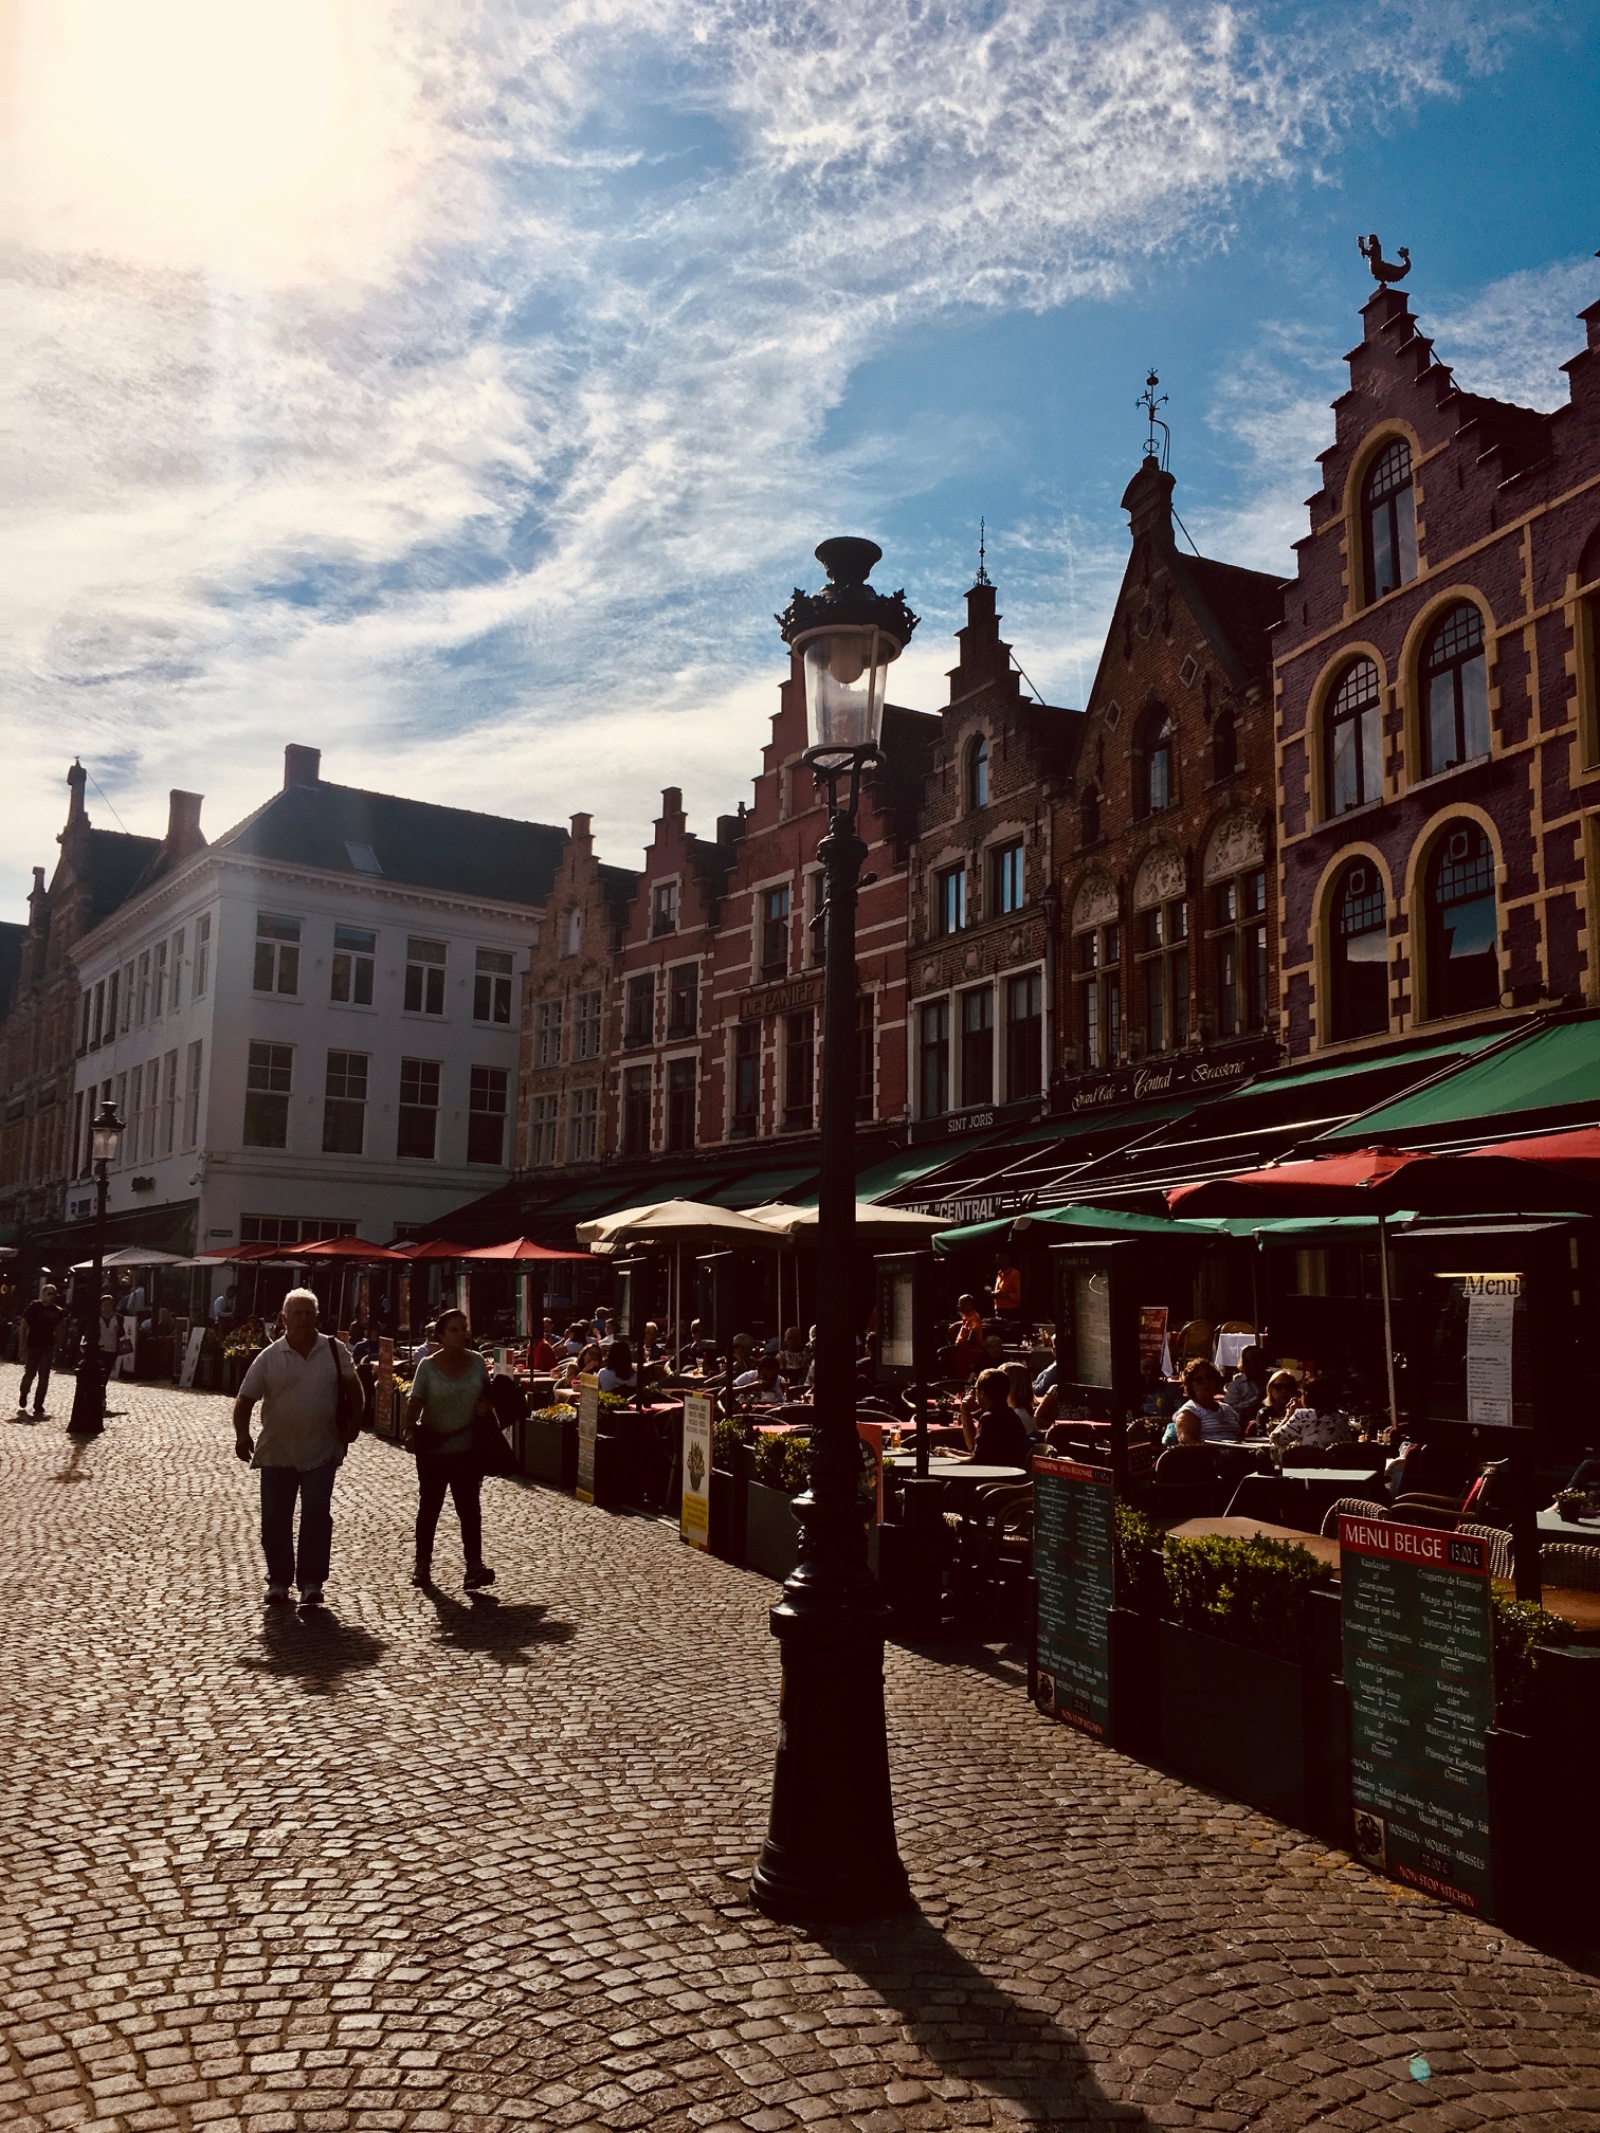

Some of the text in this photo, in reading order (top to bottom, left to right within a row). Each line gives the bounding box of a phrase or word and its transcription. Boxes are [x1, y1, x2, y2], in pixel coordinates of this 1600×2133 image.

[763, 982, 814, 1011] PANIER
[1133, 1067, 1173, 1099] Central
[1191, 1061, 1245, 1083] Brasserie
[948, 1112, 994, 1132] SINT JORIS
[1465, 1275, 1519, 1295] Menu
[1345, 1523, 1442, 1559] MENU BELGE
[1451, 1543, 1479, 1565] 15.00 €
[1417, 1569, 1483, 1592] Croquette de Fromage
[1420, 1592, 1441, 1607] Potage
[1442, 1598, 1452, 1608] aux
[1445, 1589, 1454, 1597] ou
[1453, 1623, 1461, 1633] de
[1386, 1688, 1402, 1701] Soup
[1424, 1837, 1451, 1857] MOULES
[1455, 1849, 1486, 1871] MUSSELS
[1399, 1864, 1475, 1908] NON STOP KITCHEN
